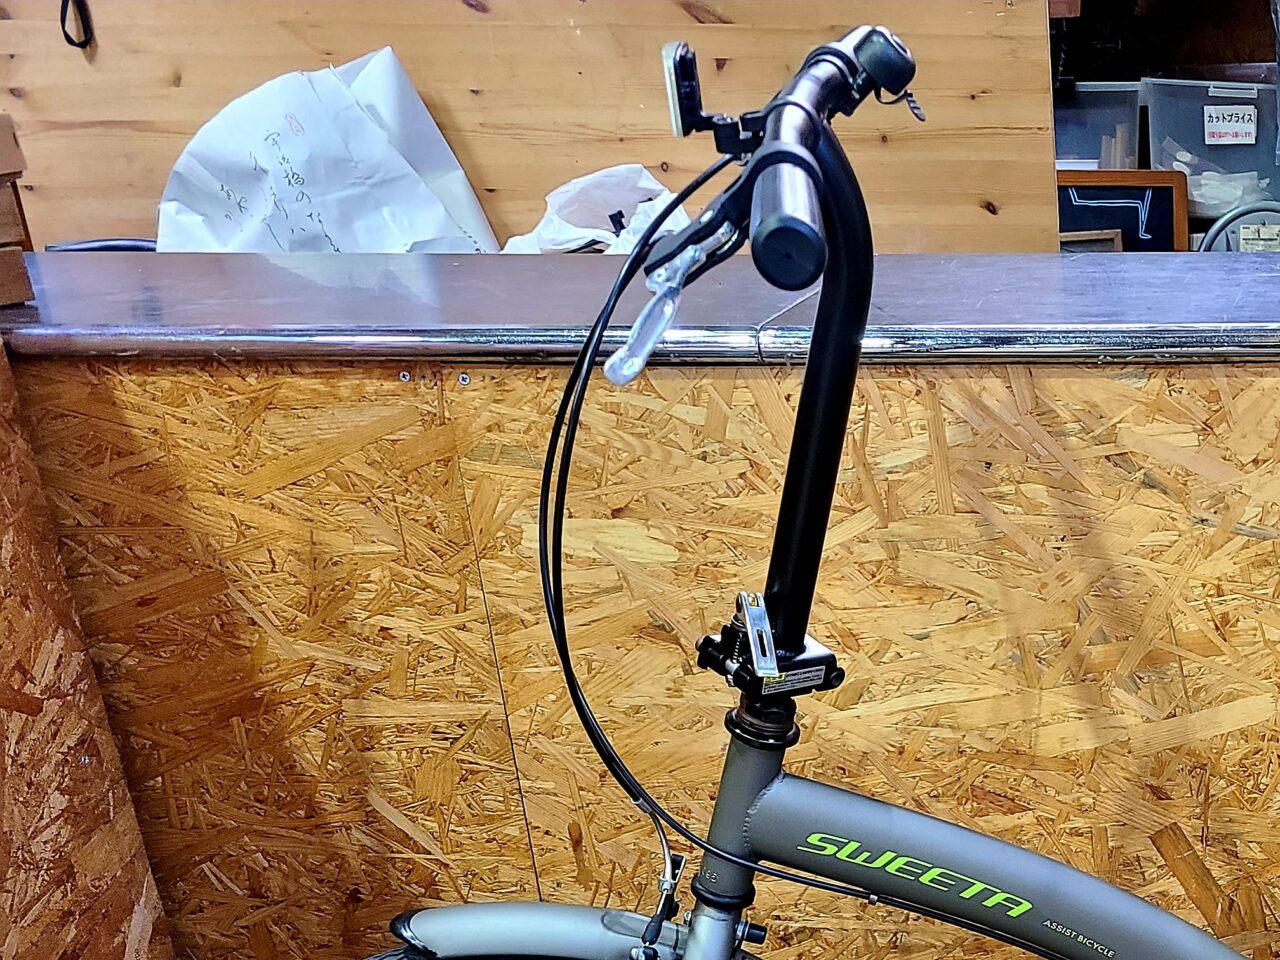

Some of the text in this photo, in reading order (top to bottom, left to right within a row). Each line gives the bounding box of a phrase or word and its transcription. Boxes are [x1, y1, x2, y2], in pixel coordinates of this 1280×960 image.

[1207, 112, 1254, 124] カットプライス
[797, 832, 1035, 918] SWEETA
[1042, 919, 1116, 959] ASSIST BICYCLE
